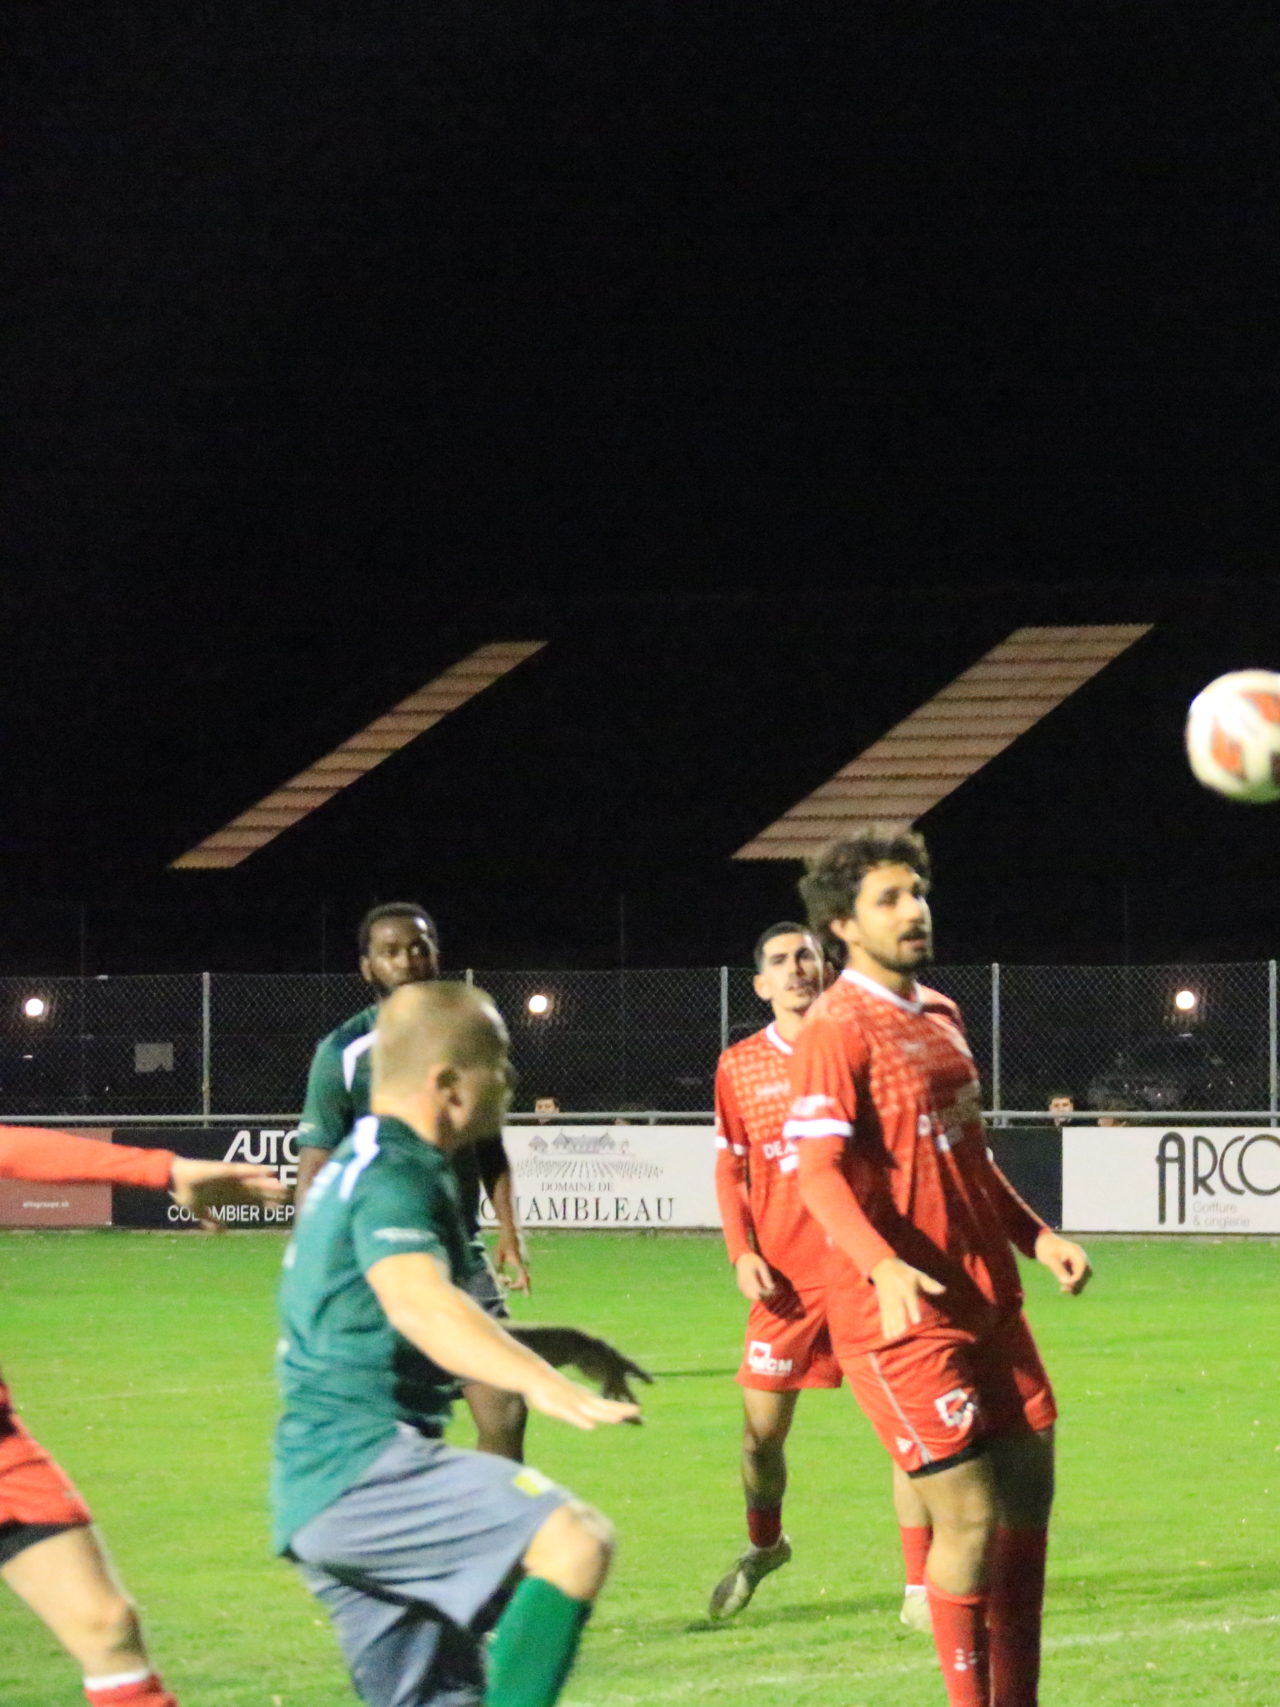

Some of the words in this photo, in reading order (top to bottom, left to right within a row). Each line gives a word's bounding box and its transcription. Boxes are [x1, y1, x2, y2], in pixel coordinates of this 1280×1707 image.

[541, 1182, 594, 1193] DOMAINE
[598, 1182, 614, 1193] DE
[167, 1204, 260, 1222] COLMBIER
